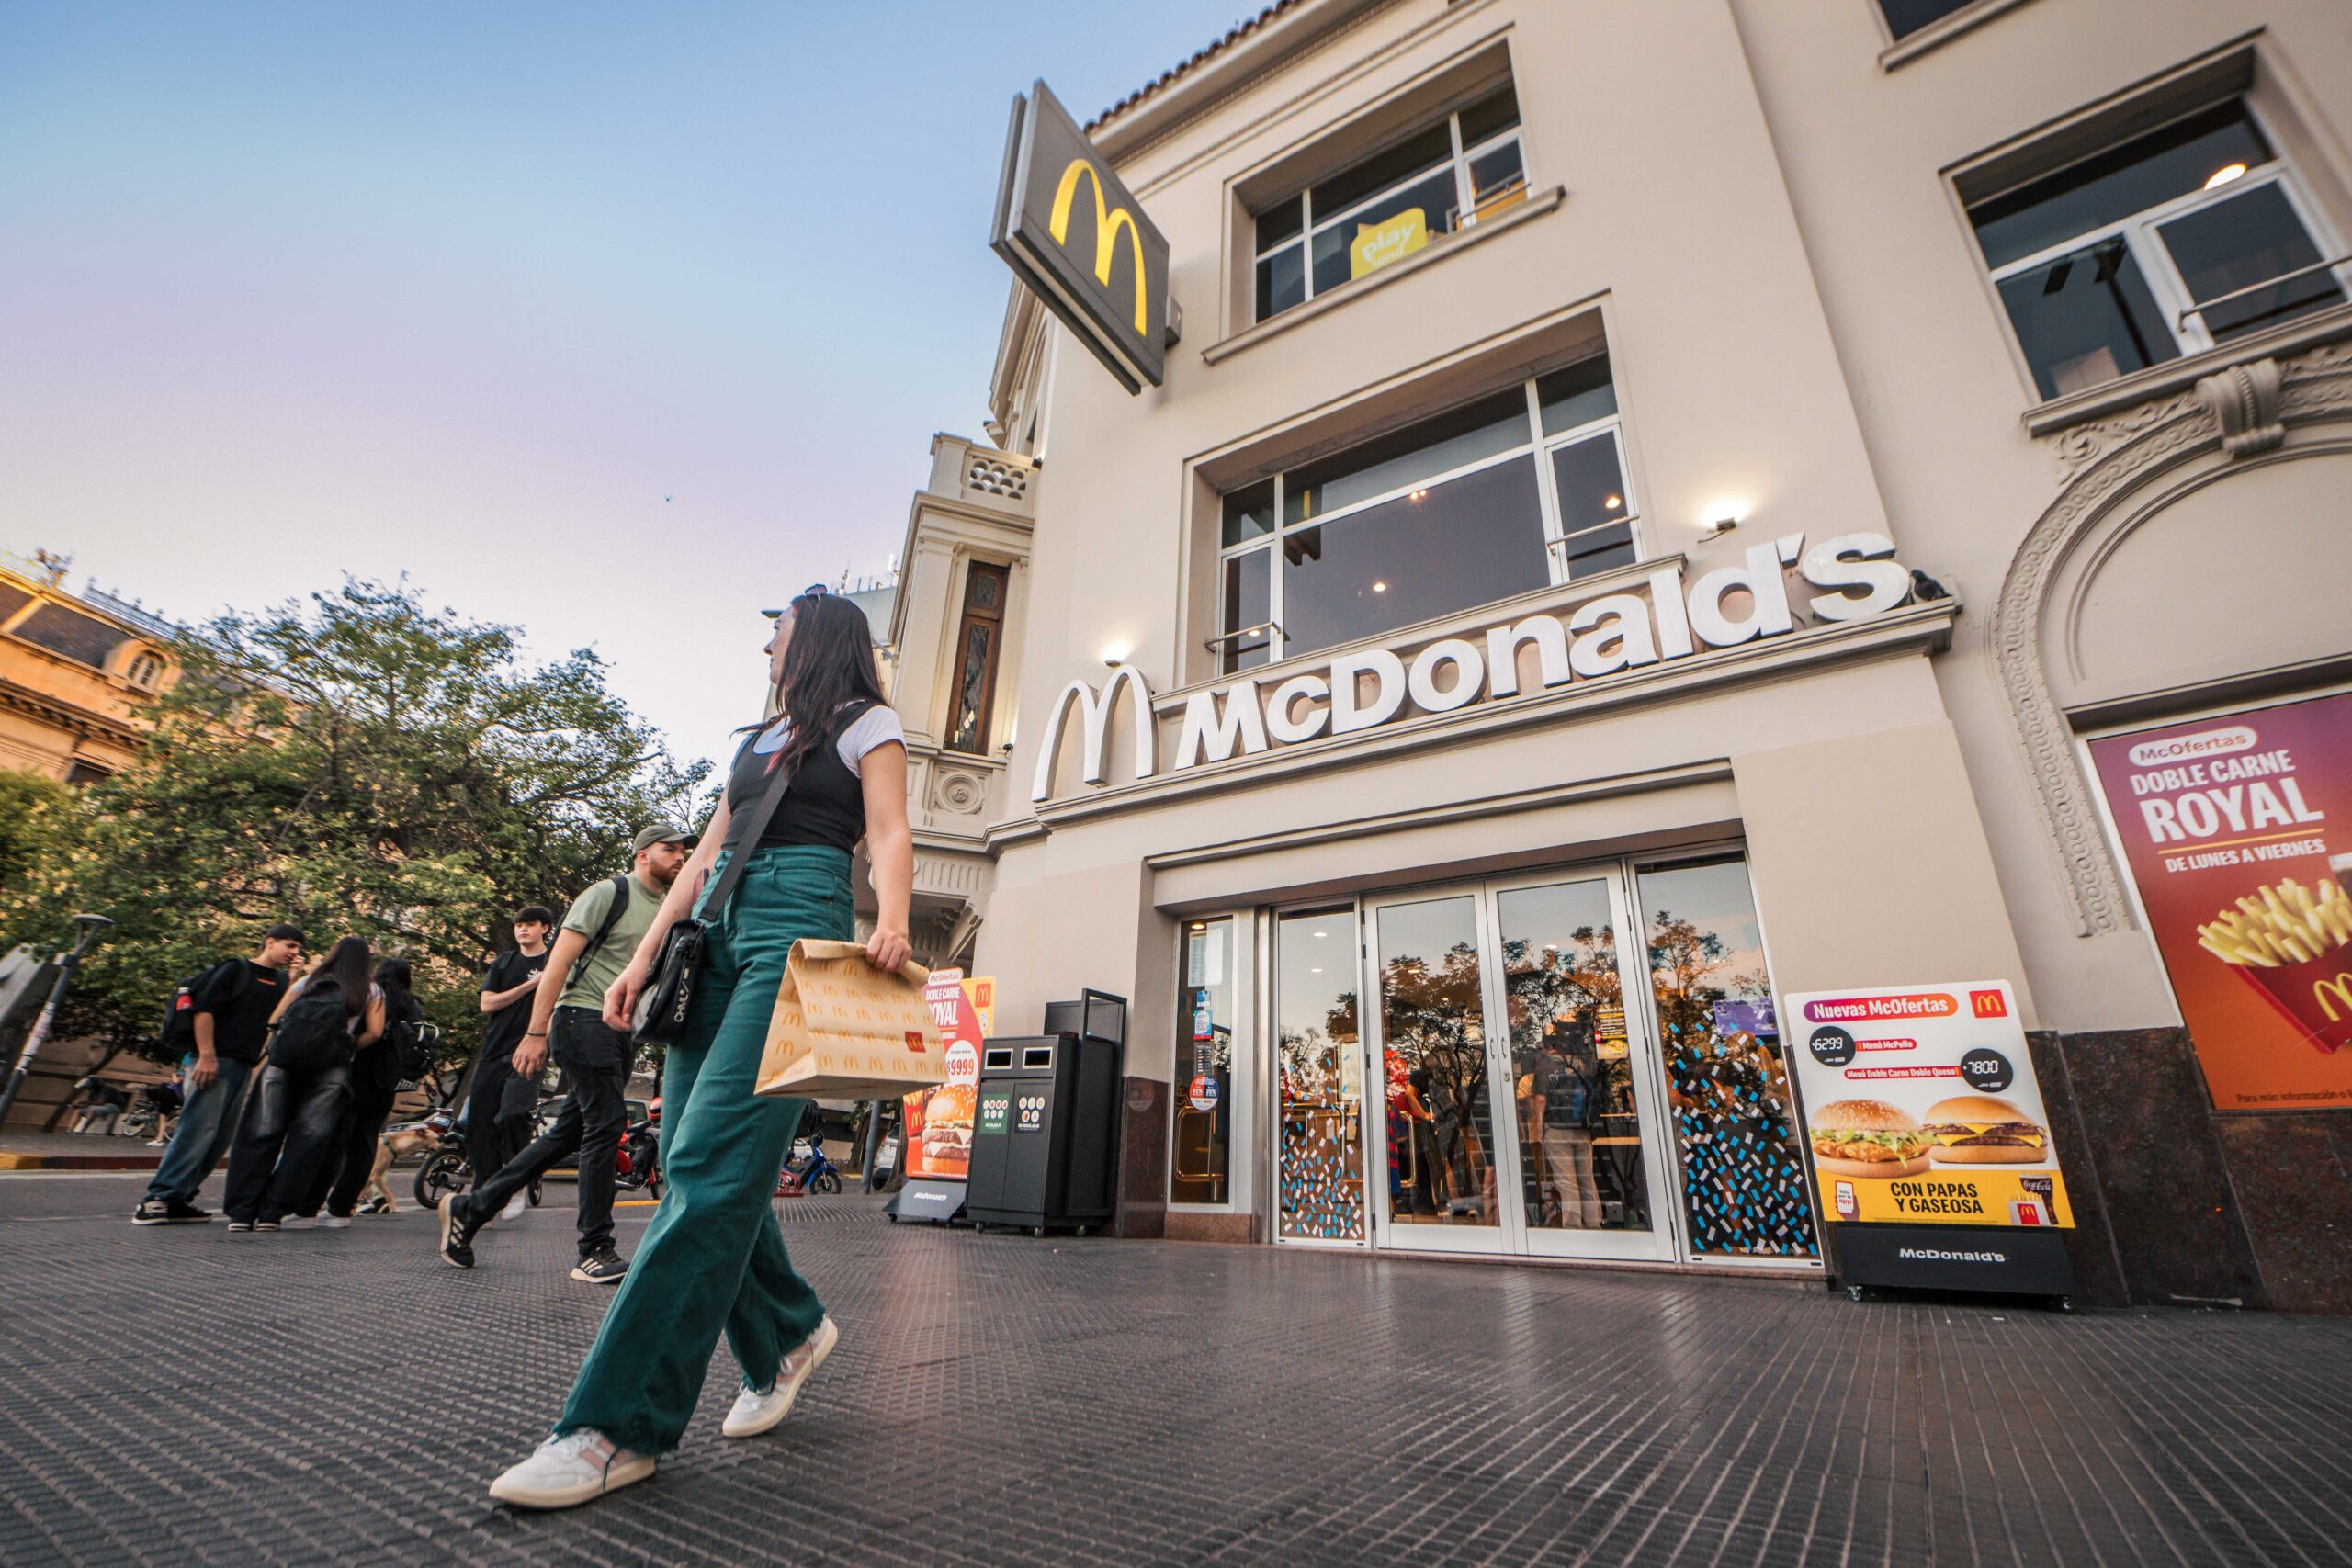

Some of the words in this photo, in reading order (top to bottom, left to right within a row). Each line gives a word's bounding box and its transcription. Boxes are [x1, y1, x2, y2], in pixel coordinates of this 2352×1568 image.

[1362, 222, 1415, 263] play
[1175, 533, 1909, 771] McDonald's
[2139, 733, 2247, 761] McOfertas
[2130, 763, 2209, 795] DOBLE
[2209, 750, 2295, 783] CARNE
[2139, 777, 2324, 843] ROYAL
[2165, 856, 2188, 873] DE
[2188, 851, 2239, 871] LUNES
[2242, 848, 2254, 863] A
[2254, 839, 2326, 862] VIERNES
[929, 1000, 959, 1026] OYAL
[1813, 1002, 1867, 1019] Nuevas
[1869, 998, 1949, 1016] McOfertas
[1811, 1037, 1843, 1051] 6299
[1862, 1040, 1883, 1050] Menú
[1883, 1040, 1913, 1049] McPollo
[1847, 1068, 1865, 1078] Menú
[1867, 1068, 1886, 1077] Doble
[1888, 1068, 1909, 1077] Carne
[1910, 1067, 1931, 1077] Doble
[1932, 1067, 1955, 1077] Queso
[1963, 1060, 1998, 1075] 7800
[1891, 1181, 1923, 1197] CON
[1926, 1182, 1978, 1198] PAPAS
[1895, 1198, 1905, 1212] Y
[1909, 1198, 1984, 1213] GASEOSA
[1899, 1248, 2006, 1263] McDonald's
